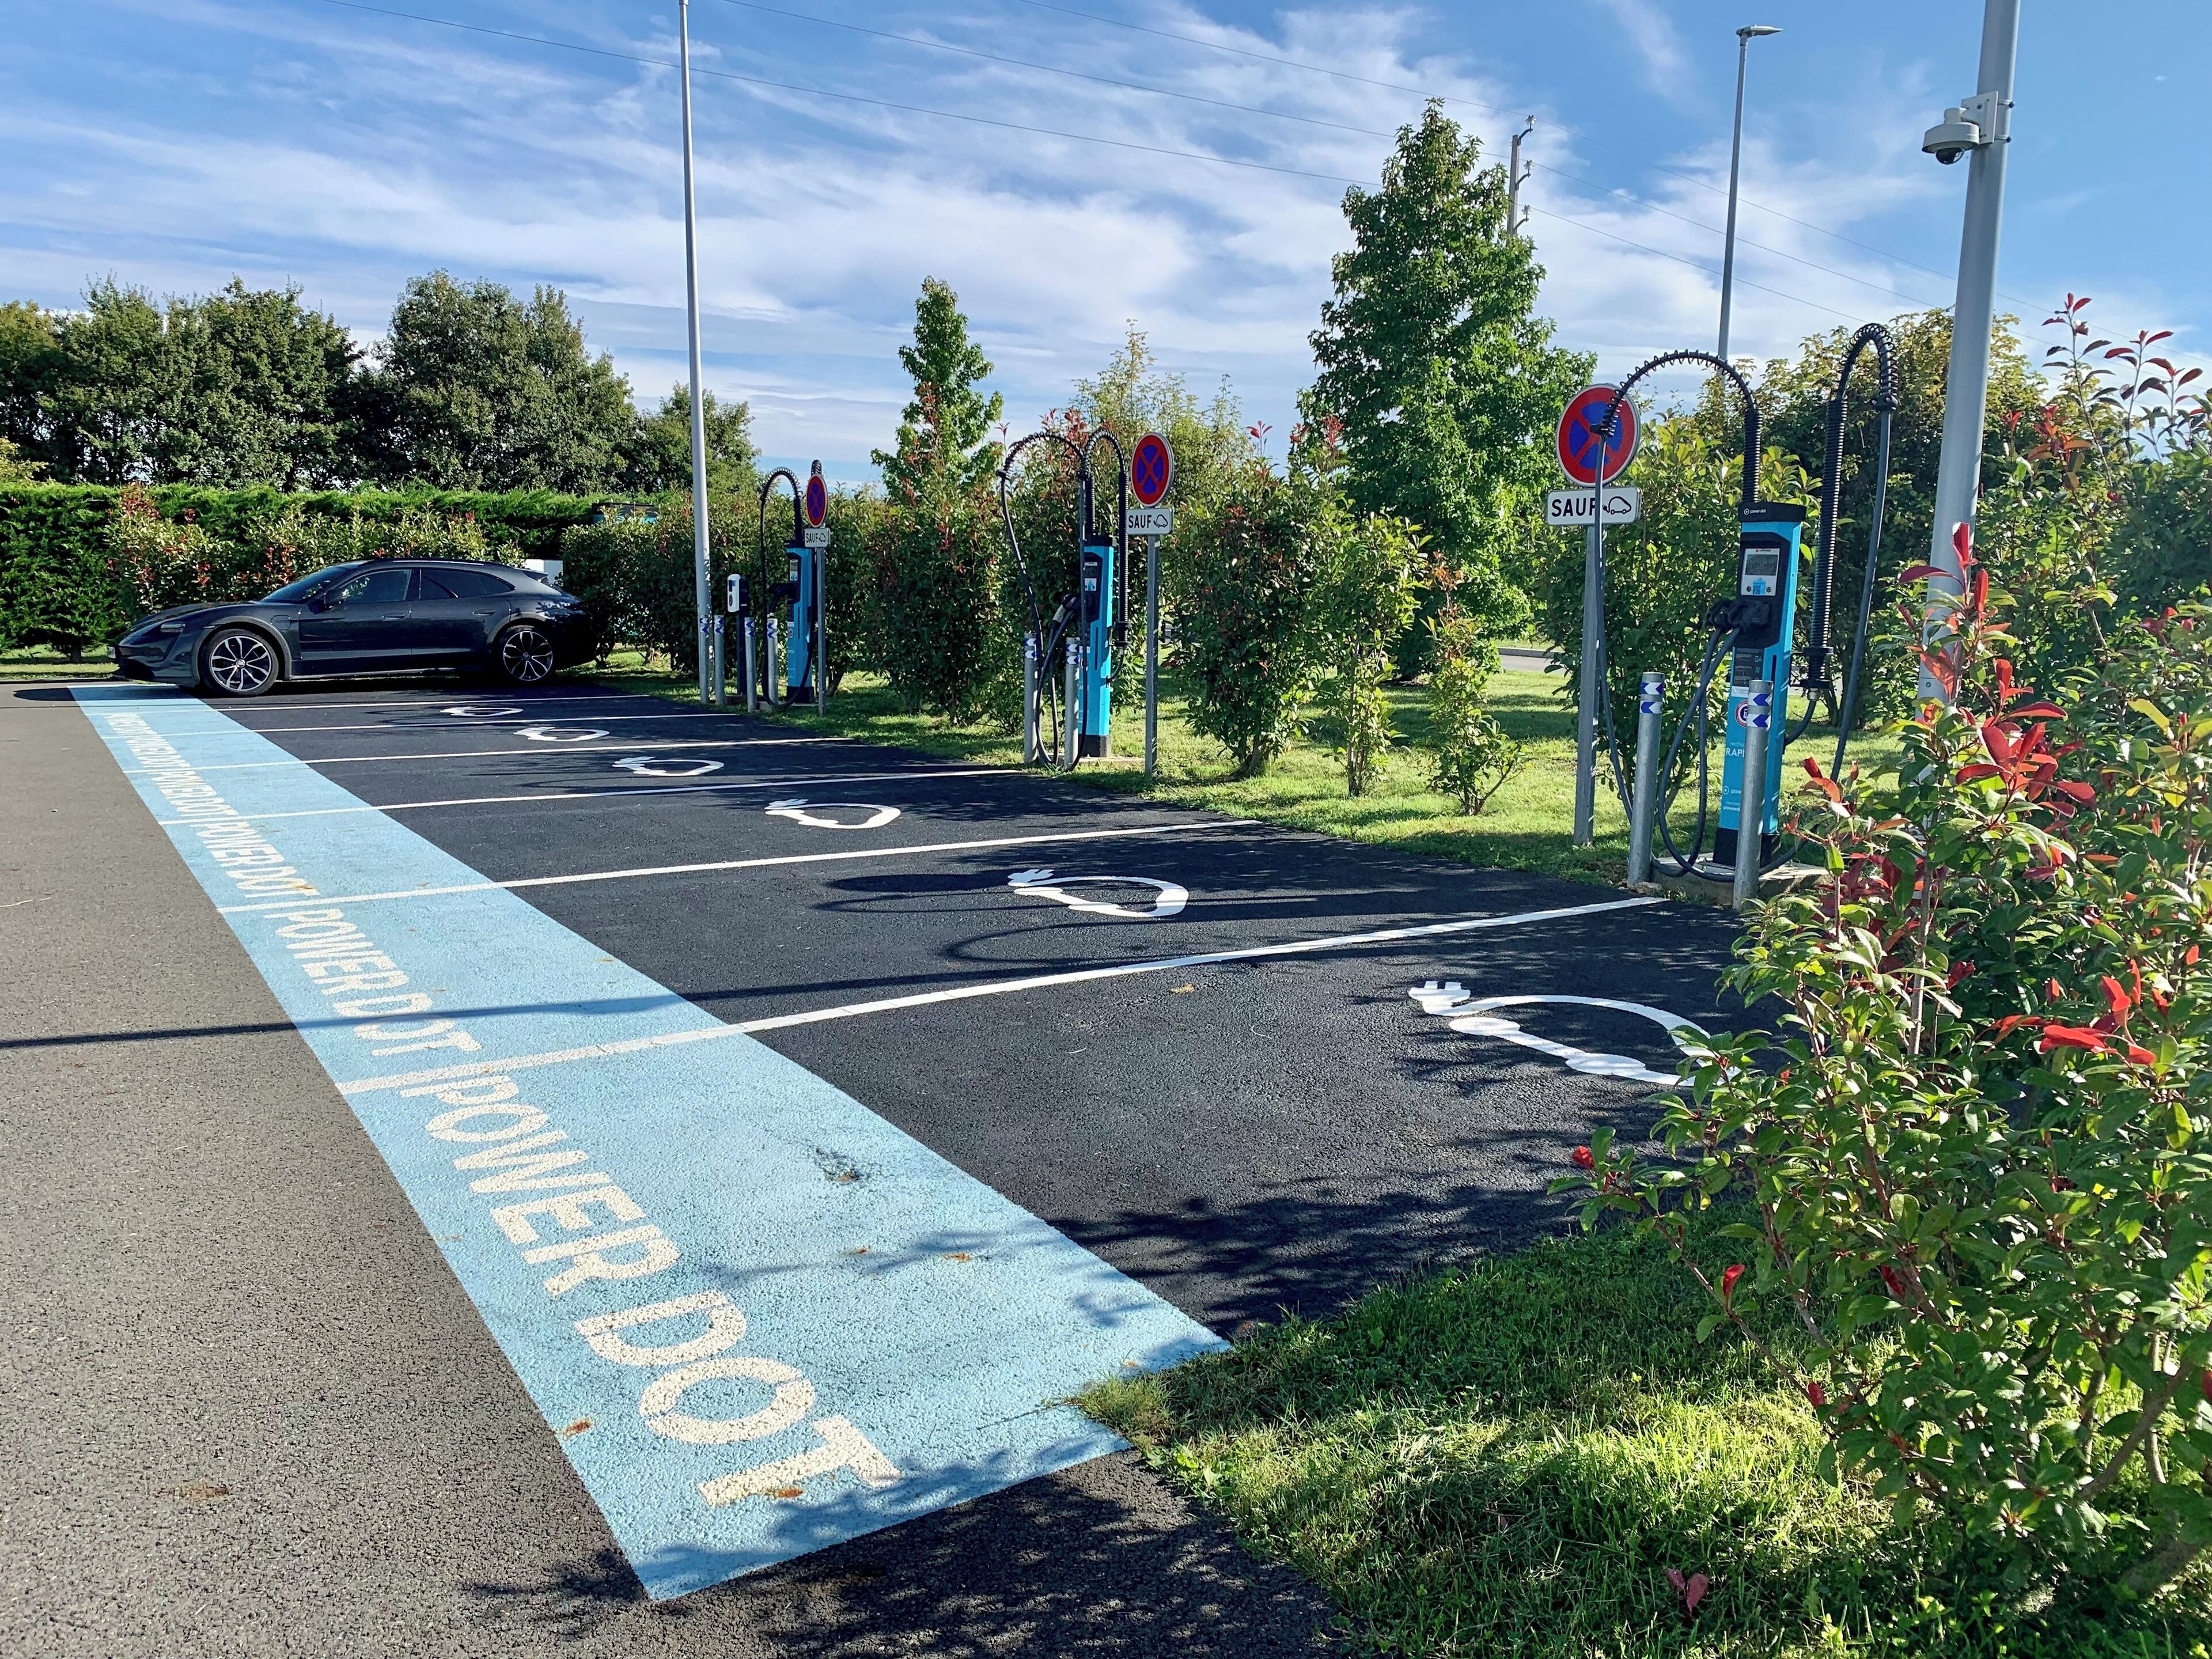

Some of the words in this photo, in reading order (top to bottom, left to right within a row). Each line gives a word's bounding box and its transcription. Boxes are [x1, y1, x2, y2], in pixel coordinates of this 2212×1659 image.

[1128, 514, 1152, 528] SAUF
[806, 533, 818, 543] SAUF
[1726, 747, 1744, 757] RAPI
[147, 771, 218, 799] POWER
[170, 797, 239, 817] DOT
[190, 821, 285, 868] POWER
[226, 866, 320, 899] DOT
[263, 908, 409, 995] POWER
[334, 993, 483, 1056] DOT
[401, 1075, 681, 1298] POWER
[576, 1289, 902, 1507] DOT
